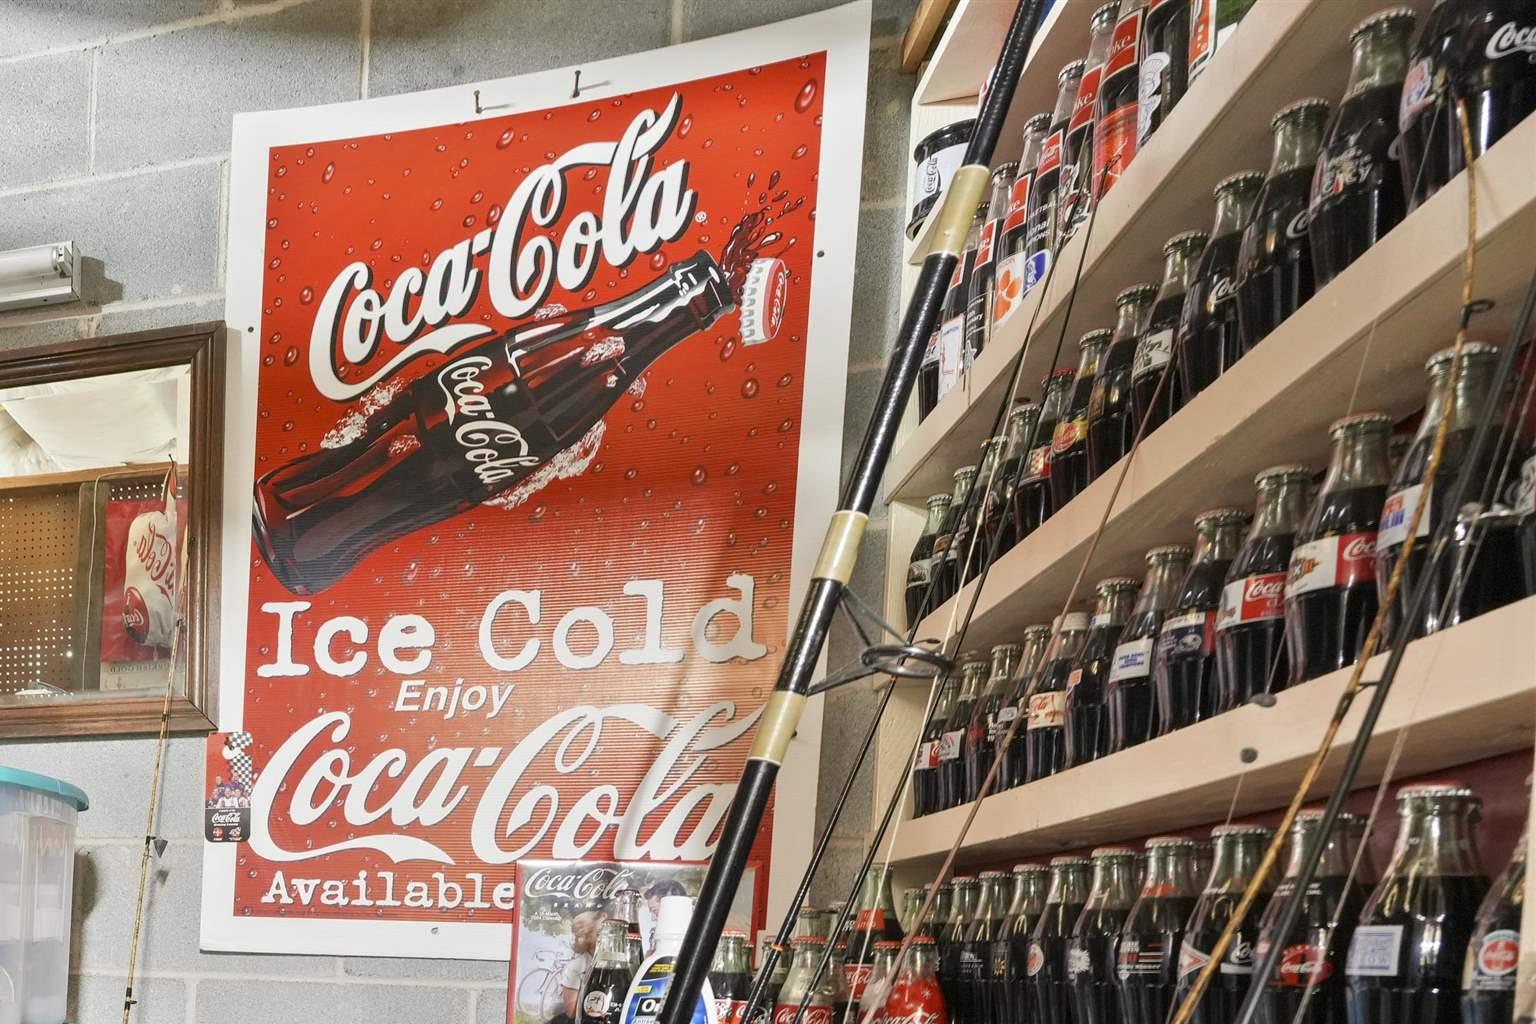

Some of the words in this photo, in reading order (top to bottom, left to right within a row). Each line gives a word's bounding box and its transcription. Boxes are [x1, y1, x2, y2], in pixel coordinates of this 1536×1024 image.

[309, 92, 696, 402] Coca-Cola
[436, 355, 539, 485] Coca-Cola
[257, 600, 437, 678] Ice
[478, 574, 768, 672] Cold
[394, 678, 516, 720] Enjoy
[246, 700, 768, 867] Coca-Cola
[259, 869, 515, 910] Available
